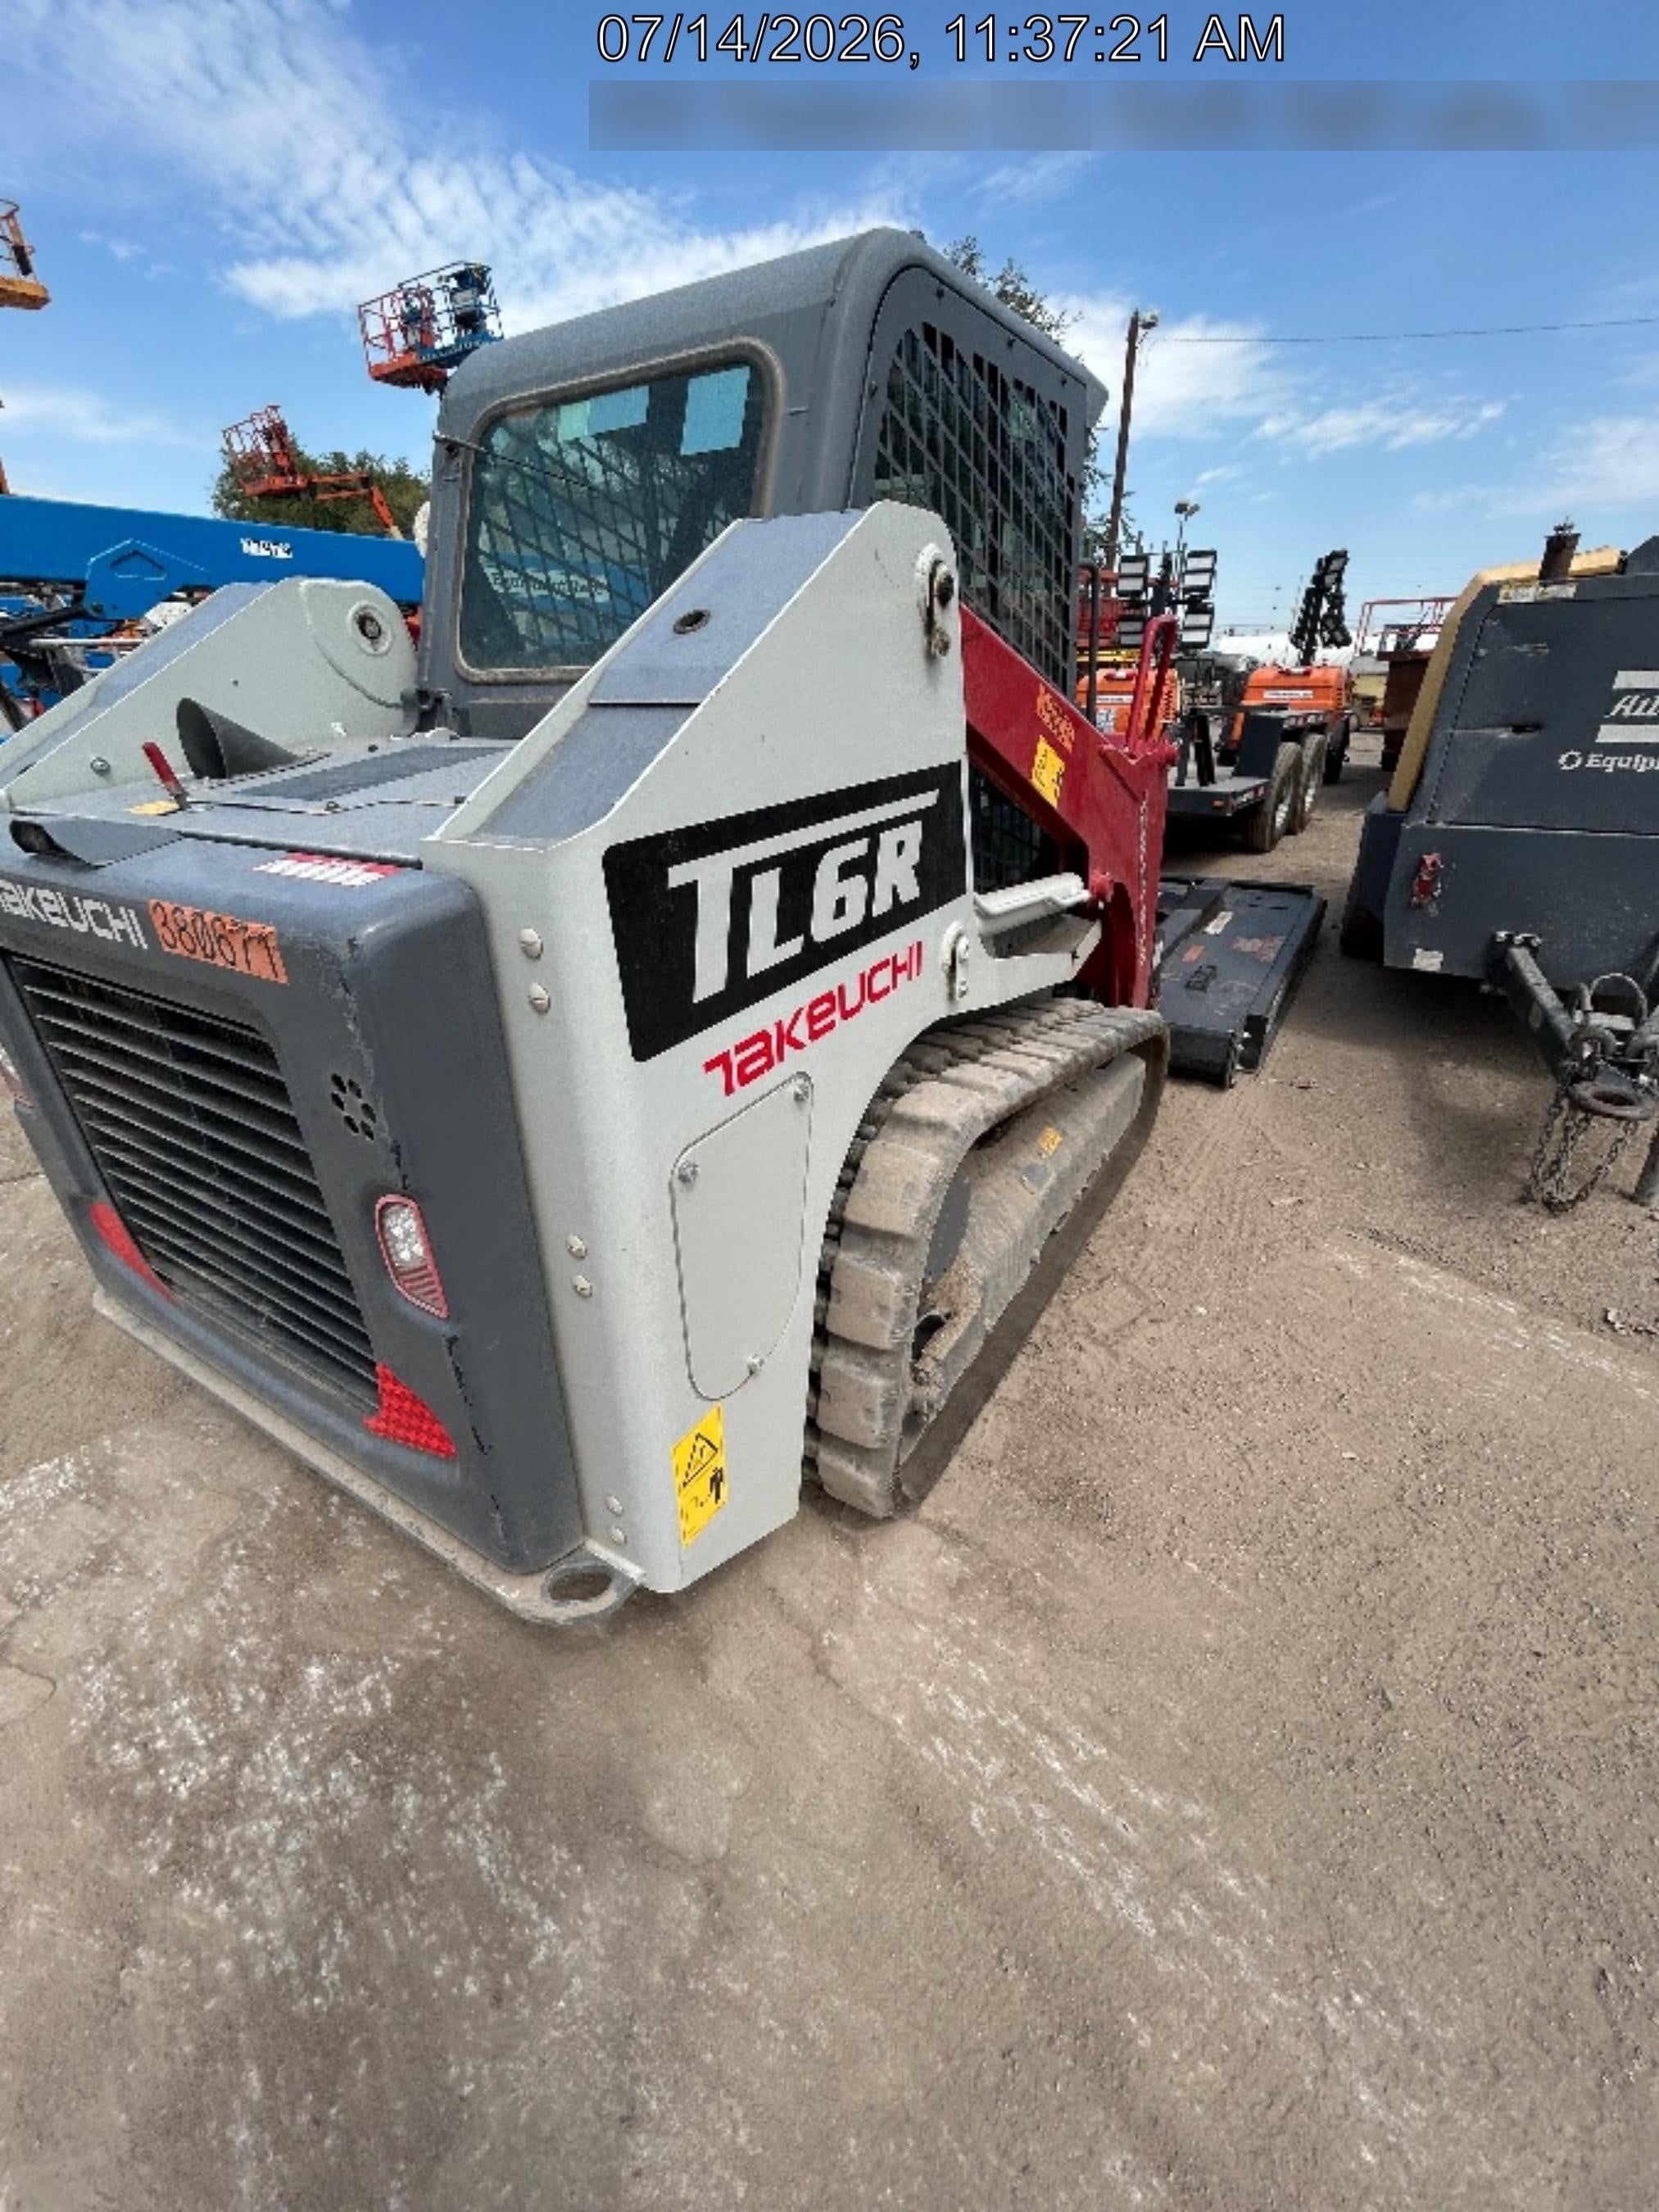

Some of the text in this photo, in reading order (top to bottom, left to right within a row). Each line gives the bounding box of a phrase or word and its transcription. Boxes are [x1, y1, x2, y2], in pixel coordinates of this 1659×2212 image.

[1584, 753, 1659, 773] Equip
[0, 879, 148, 950] AKEUCHI
[666, 788, 941, 1004] TL6R
